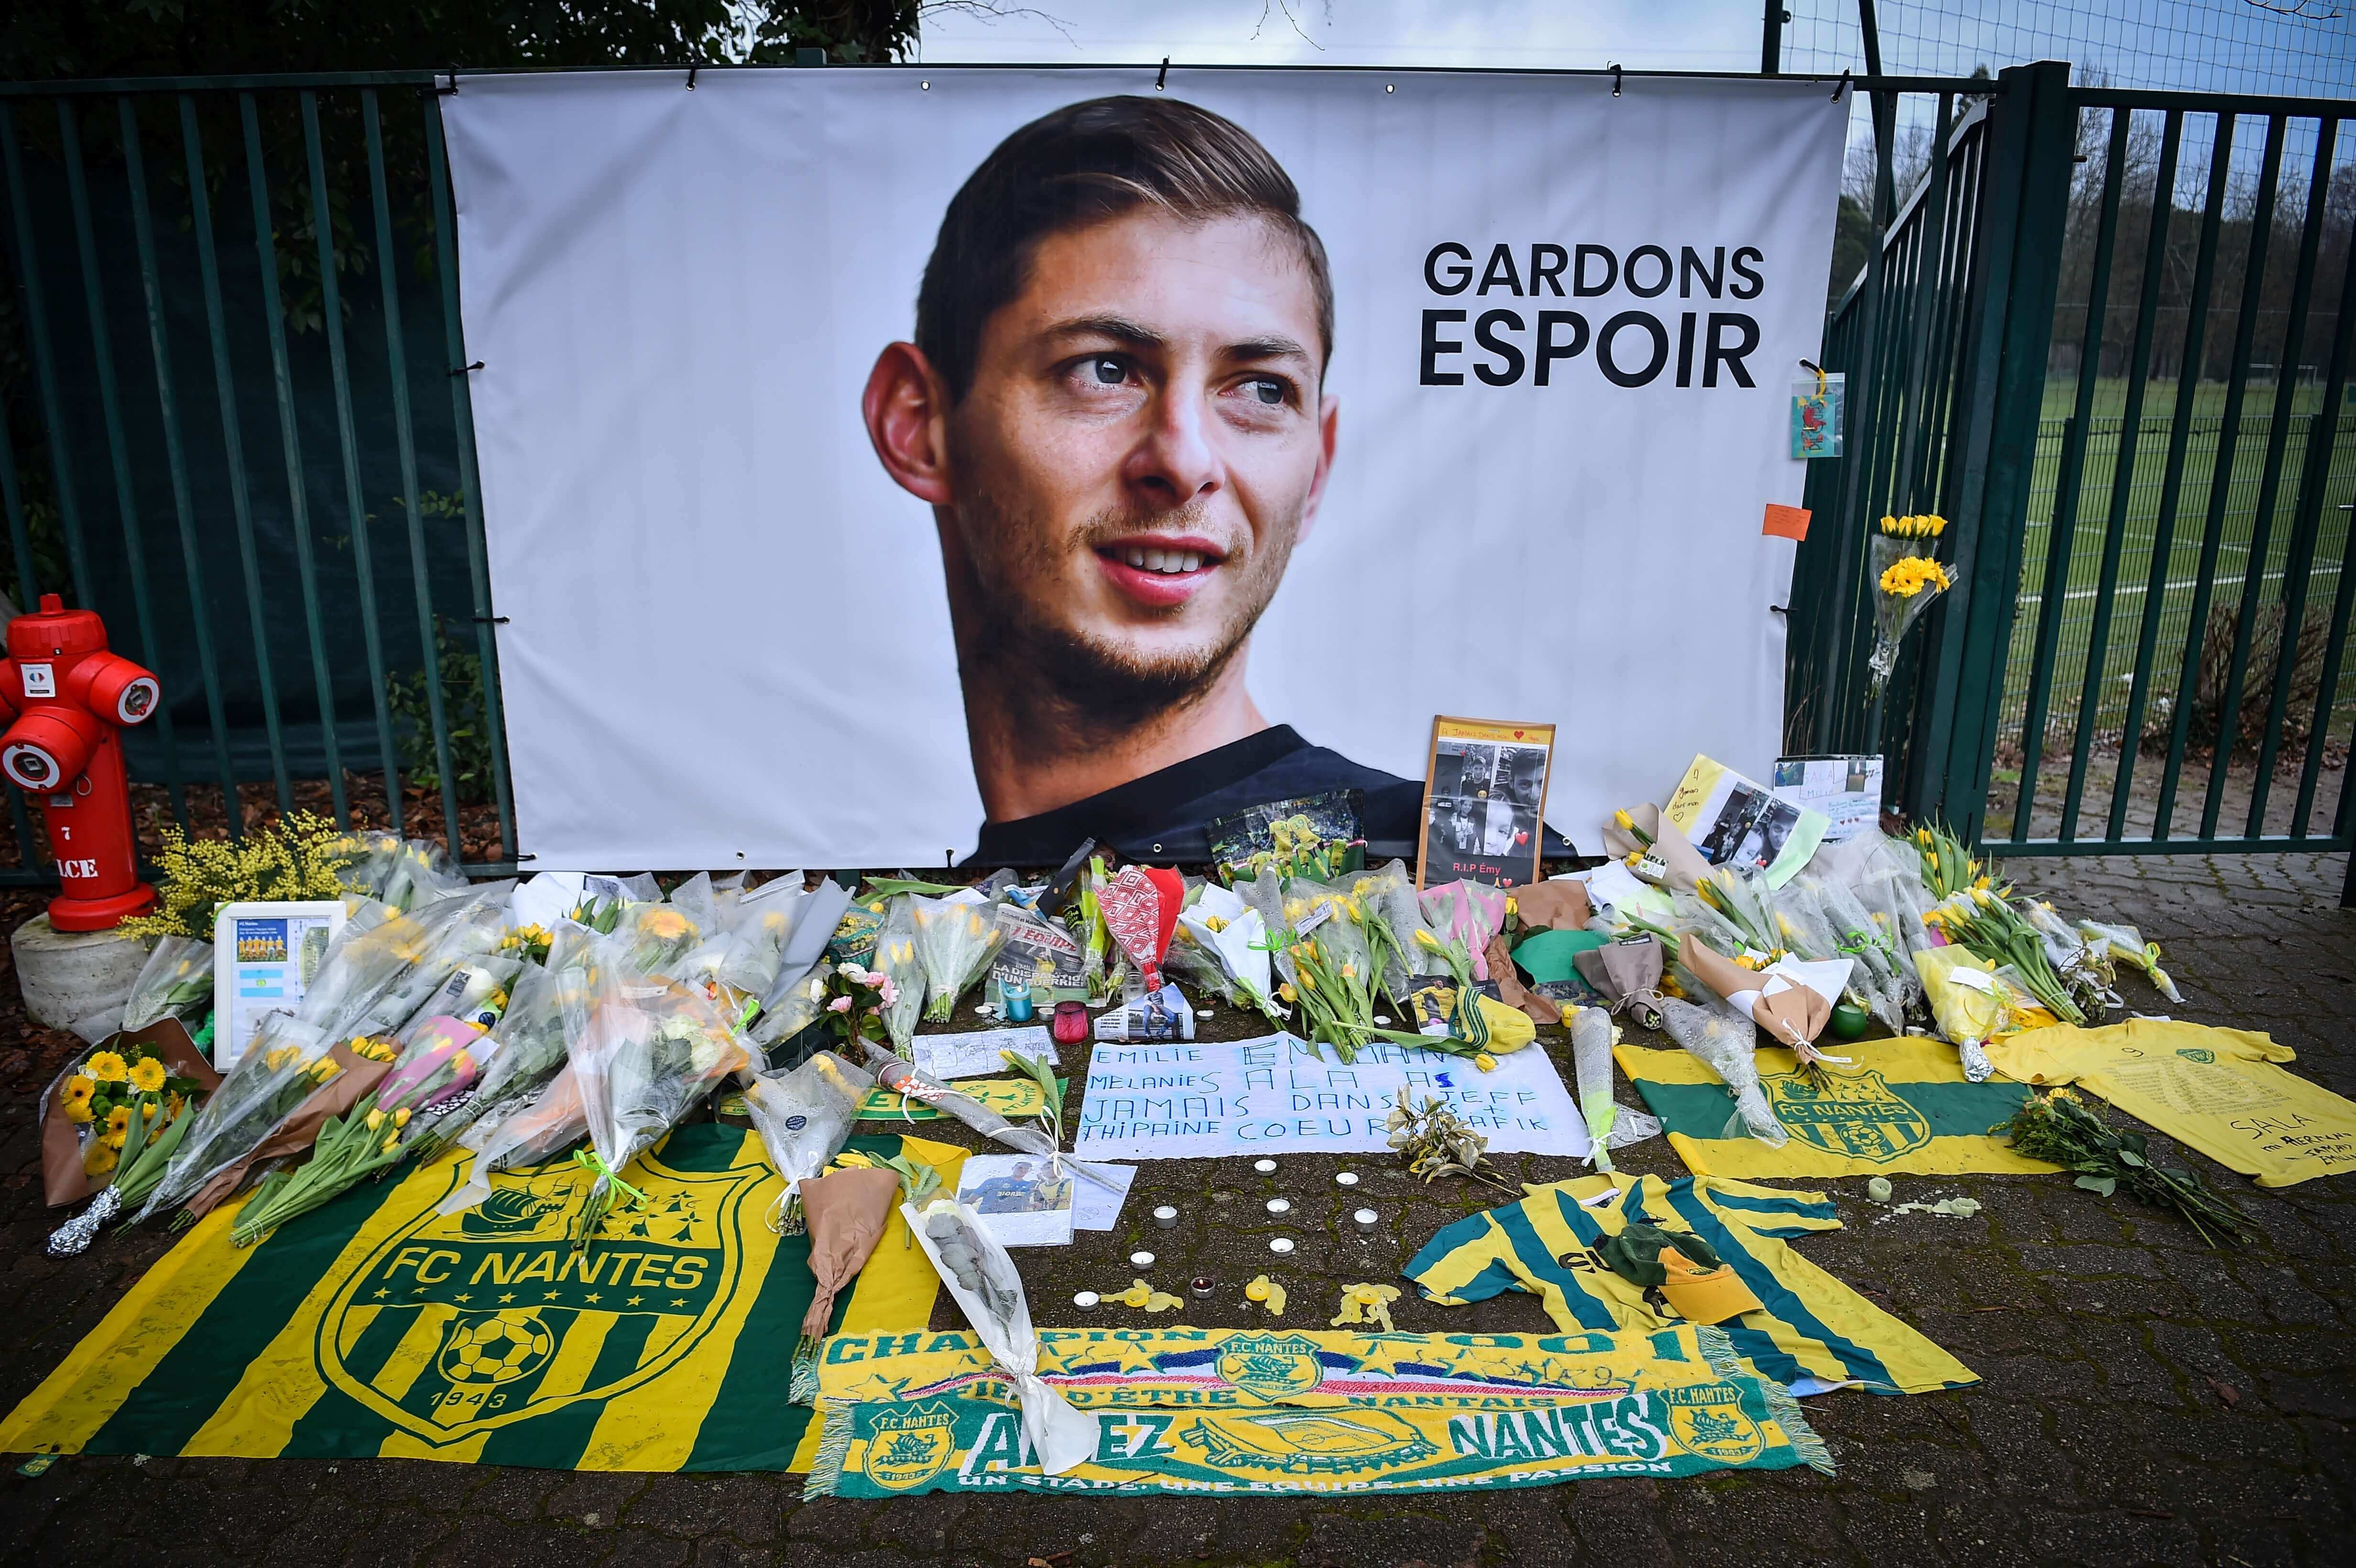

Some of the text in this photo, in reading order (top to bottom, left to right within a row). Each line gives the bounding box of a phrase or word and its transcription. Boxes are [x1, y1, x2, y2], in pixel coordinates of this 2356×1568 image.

[1424, 242, 1765, 300] GARDONS
[1419, 308, 1760, 388] ESPOIR
[61, 826, 70, 840] 7
[1453, 862, 1501, 875] R.I.P Émy
[993, 962, 1010, 972] LA
[1438, 1090, 1536, 1105] JEFF
[1085, 1094, 1458, 1123] JAMAIS DANS NS
[1778, 1104, 1909, 1116] FC NANTES
[1238, 1118, 1419, 1140] COEUR
[2230, 1112, 2319, 1140] SALA
[383, 1246, 709, 1291] FC NANTES
[825, 1329, 1206, 1365] CHAPION
[1255, 1342, 1307, 1354] NANTES
[429, 1391, 507, 1409] 1943
[1349, 1395, 1557, 1408] NANTAIS
[1691, 1387, 1736, 1404] NANTES
[903, 1413, 950, 1428] NANTES
[958, 1394, 1667, 1477] AEZ NANTES
[959, 1474, 1008, 1485] UN
[1161, 1480, 1244, 1492] UNE
[1416, 1474, 1494, 1488] UNE
[1509, 1461, 1672, 1482] PASSION
